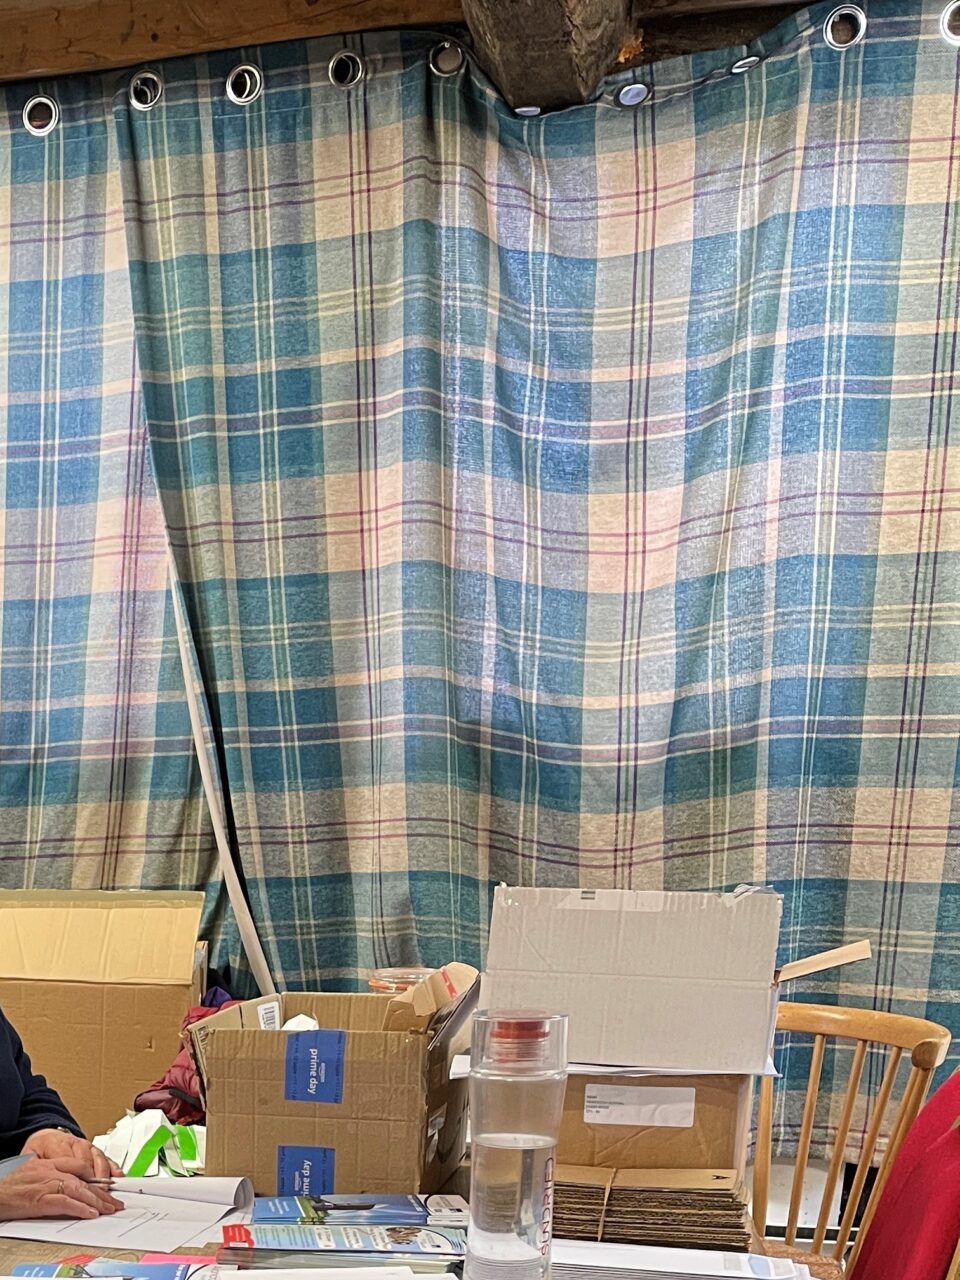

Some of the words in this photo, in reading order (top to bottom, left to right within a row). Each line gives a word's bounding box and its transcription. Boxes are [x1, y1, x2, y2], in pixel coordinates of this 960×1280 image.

[309, 1048, 319, 1077] prime
[307, 1077, 318, 1095] day
[301, 1160, 312, 1176] day
[540, 1157, 554, 1256] SUNDRIED
